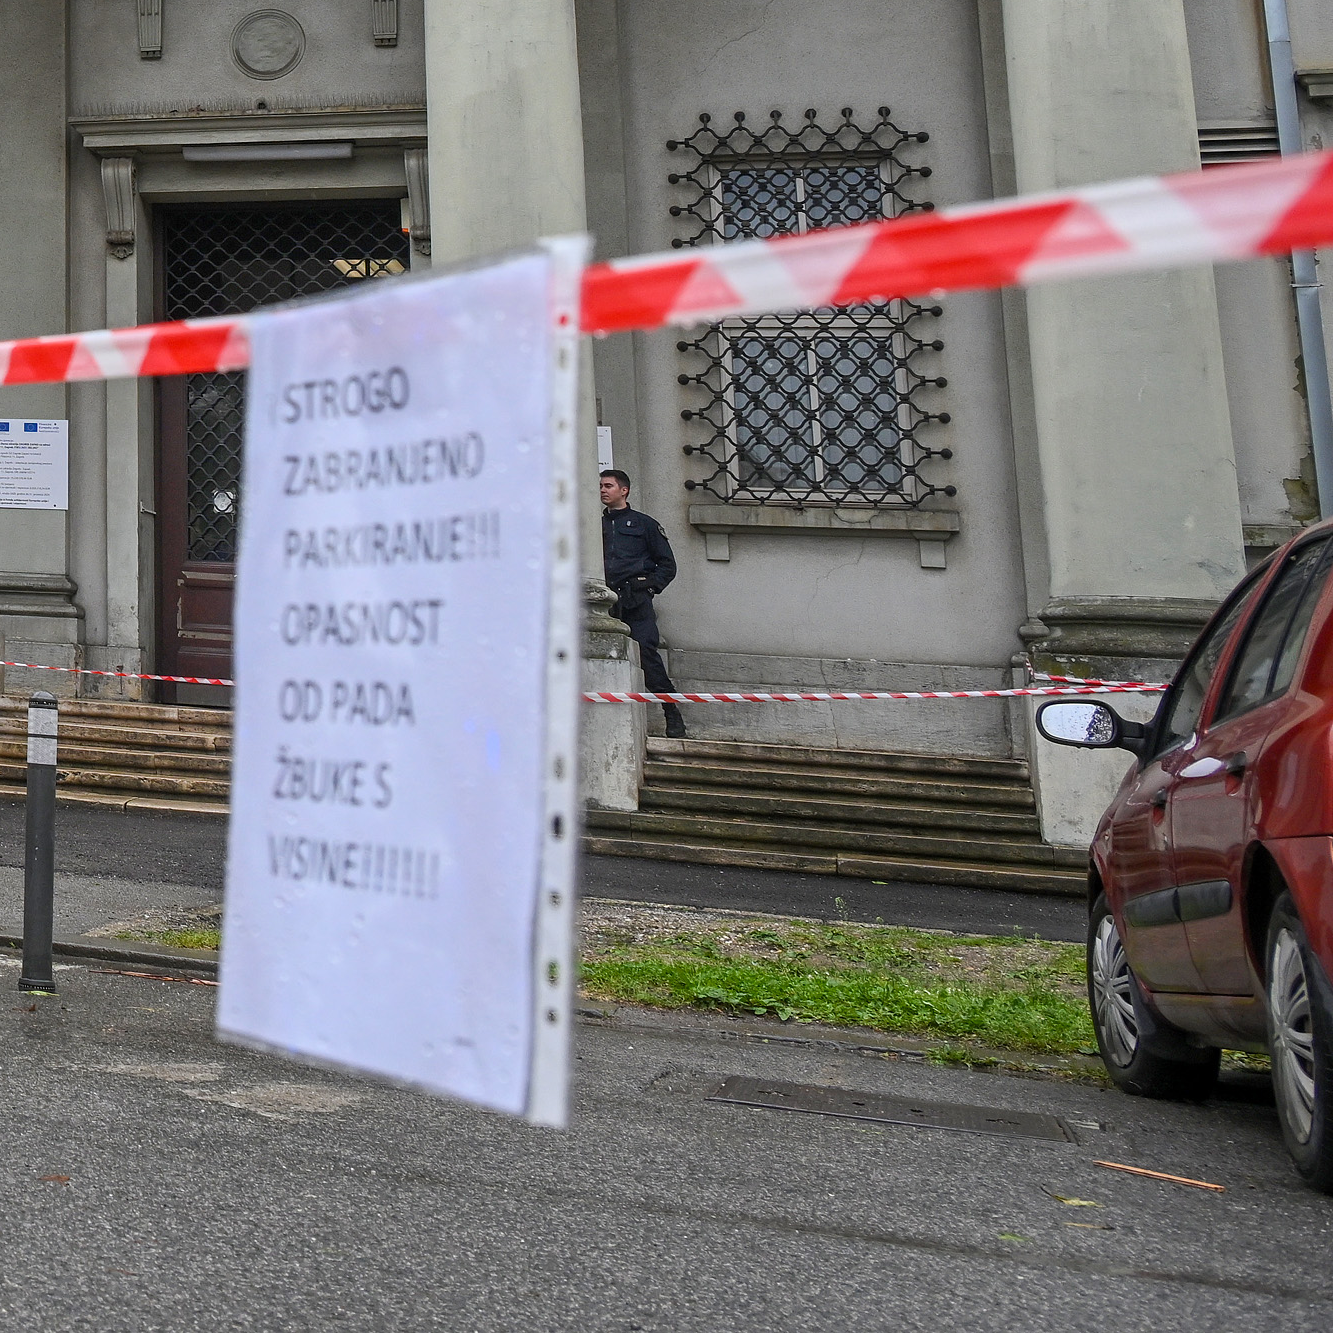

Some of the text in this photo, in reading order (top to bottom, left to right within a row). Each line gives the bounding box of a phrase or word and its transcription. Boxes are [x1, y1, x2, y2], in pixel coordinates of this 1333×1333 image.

[283, 365, 411, 425] STROGO
[283, 431, 486, 498] ZABRANJENO
[284, 511, 502, 570] PARKIRANJE!!!
[281, 598, 445, 647] OPASNOST
[279, 678, 416, 727] OD PADA
[272, 744, 393, 809] ŽBUKE S
